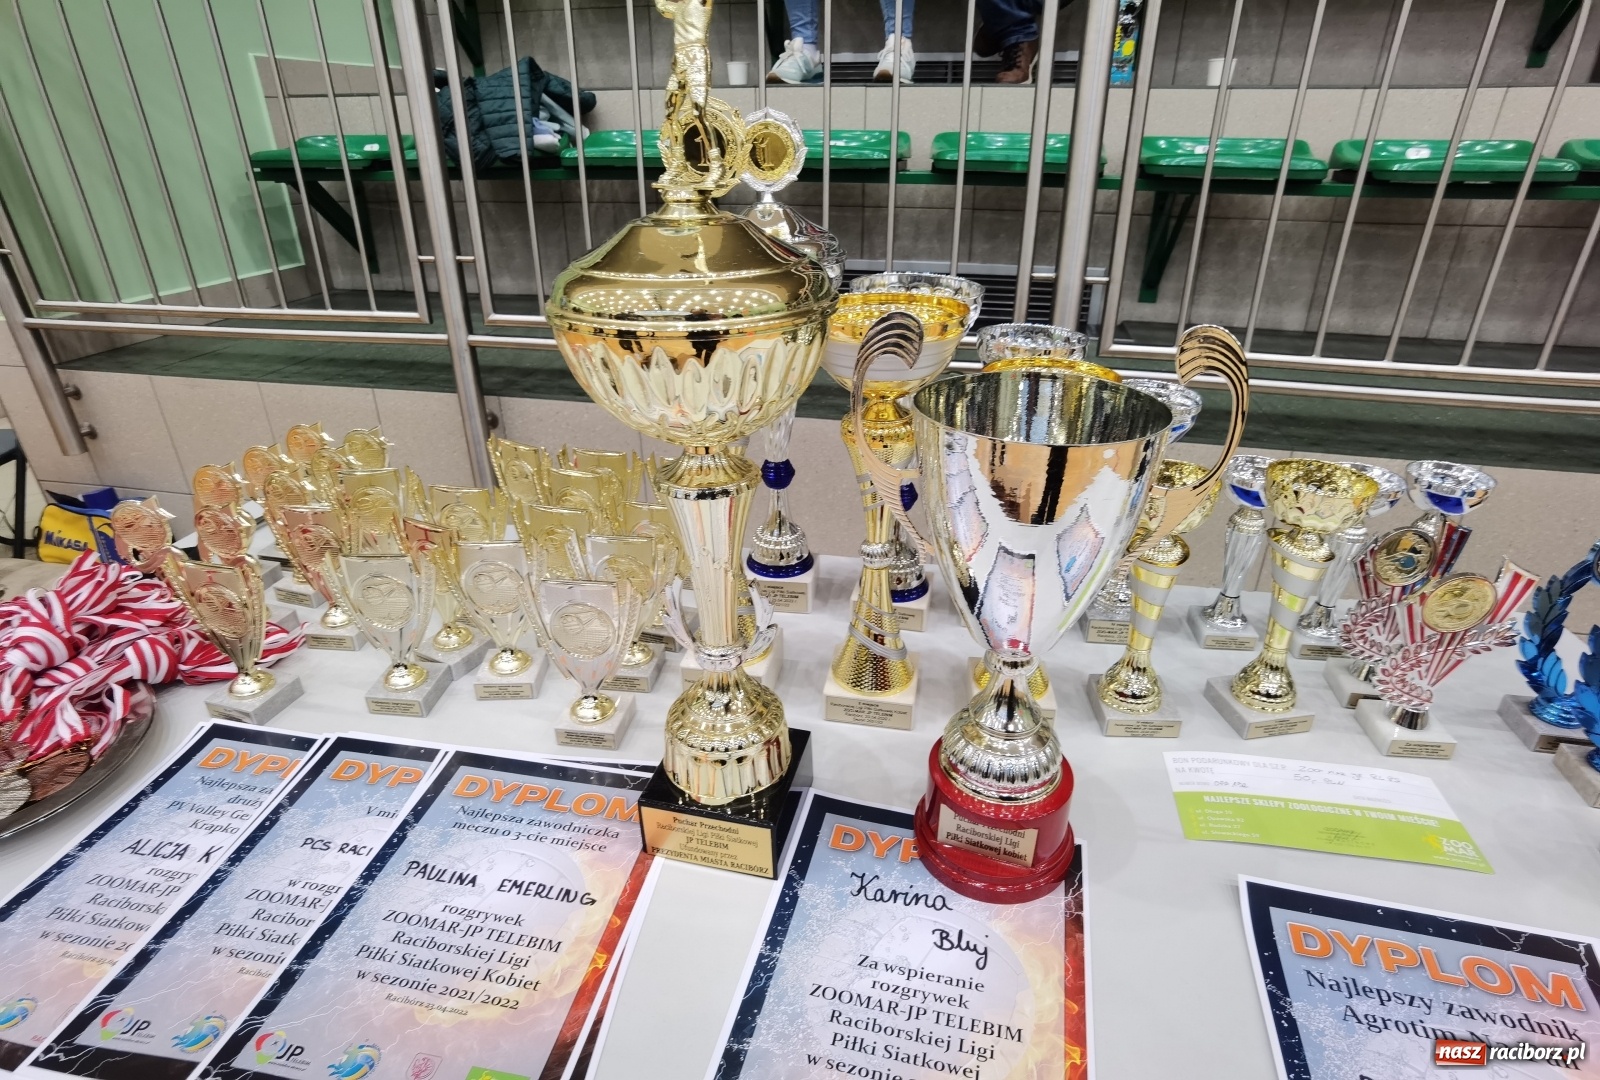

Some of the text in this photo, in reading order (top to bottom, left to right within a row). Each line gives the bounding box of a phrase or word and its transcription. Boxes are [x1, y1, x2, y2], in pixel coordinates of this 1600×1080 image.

[195, 775, 257, 794] Najlepsza
[188, 803, 231, 819] Volley
[452, 773, 640, 824] DYPLOM
[1203, 795, 1250, 805] NAJLEPSZE
[1253, 798, 1285, 809] SKLEPY
[1288, 802, 1352, 816] ZOOLOGICZNE
[1354, 809, 1362, 817] W
[1365, 810, 1397, 821] TWOIM
[455, 805, 620, 840] Najlepsza zawodniczka
[672, 816, 740, 835] Puchar Przechodni
[300, 837, 332, 851] PCS
[452, 820, 608, 854] meczu o 3-cie miejsce
[695, 837, 729, 850] TELEBIM
[956, 823, 1020, 849] Raciborskiej Ligi
[964, 837, 1002, 855] Siatkowej
[1003, 847, 1028, 861] kobiet
[1440, 836, 1474, 850] ZOO
[121, 838, 190, 861] ALICJA
[651, 846, 770, 875] PREZYDENTA MIASTA RACIBÓRZ
[1443, 845, 1480, 858] MAR
[85, 873, 182, 898] ZOOMAR-JP
[286, 879, 301, 888] w
[402, 860, 598, 908] PAULINA EMERLING
[849, 870, 954, 913] Karina
[45, 906, 90, 923] Piłki
[440, 904, 526, 927] rozgrywek
[38, 930, 53, 940] w
[54, 932, 116, 949] sezonie
[214, 922, 258, 939] Piłki
[382, 909, 564, 954] ZOOMAR-JP TELEBIM
[211, 945, 227, 956] w
[390, 930, 532, 970] Raciborskiej Ligi
[354, 944, 542, 992] Piłki Siatkowej Kobiet
[856, 953, 986, 993] Za wspieranie
[1287, 921, 1586, 1011] DYPLOM
[356, 969, 520, 1010] w sezonie 2021/2022
[385, 992, 424, 1007] Racibórz
[870, 979, 970, 1010] rozgrywek
[808, 983, 1024, 1043] ZOOMAR-JP TELEBIM
[1303, 968, 1583, 1041] Najlepszy zawodnik
[828, 1008, 996, 1062] Raciborskiej Ligi
[806, 1053, 822, 1066] w
[830, 1031, 981, 1080] Piłki Siatkowej
